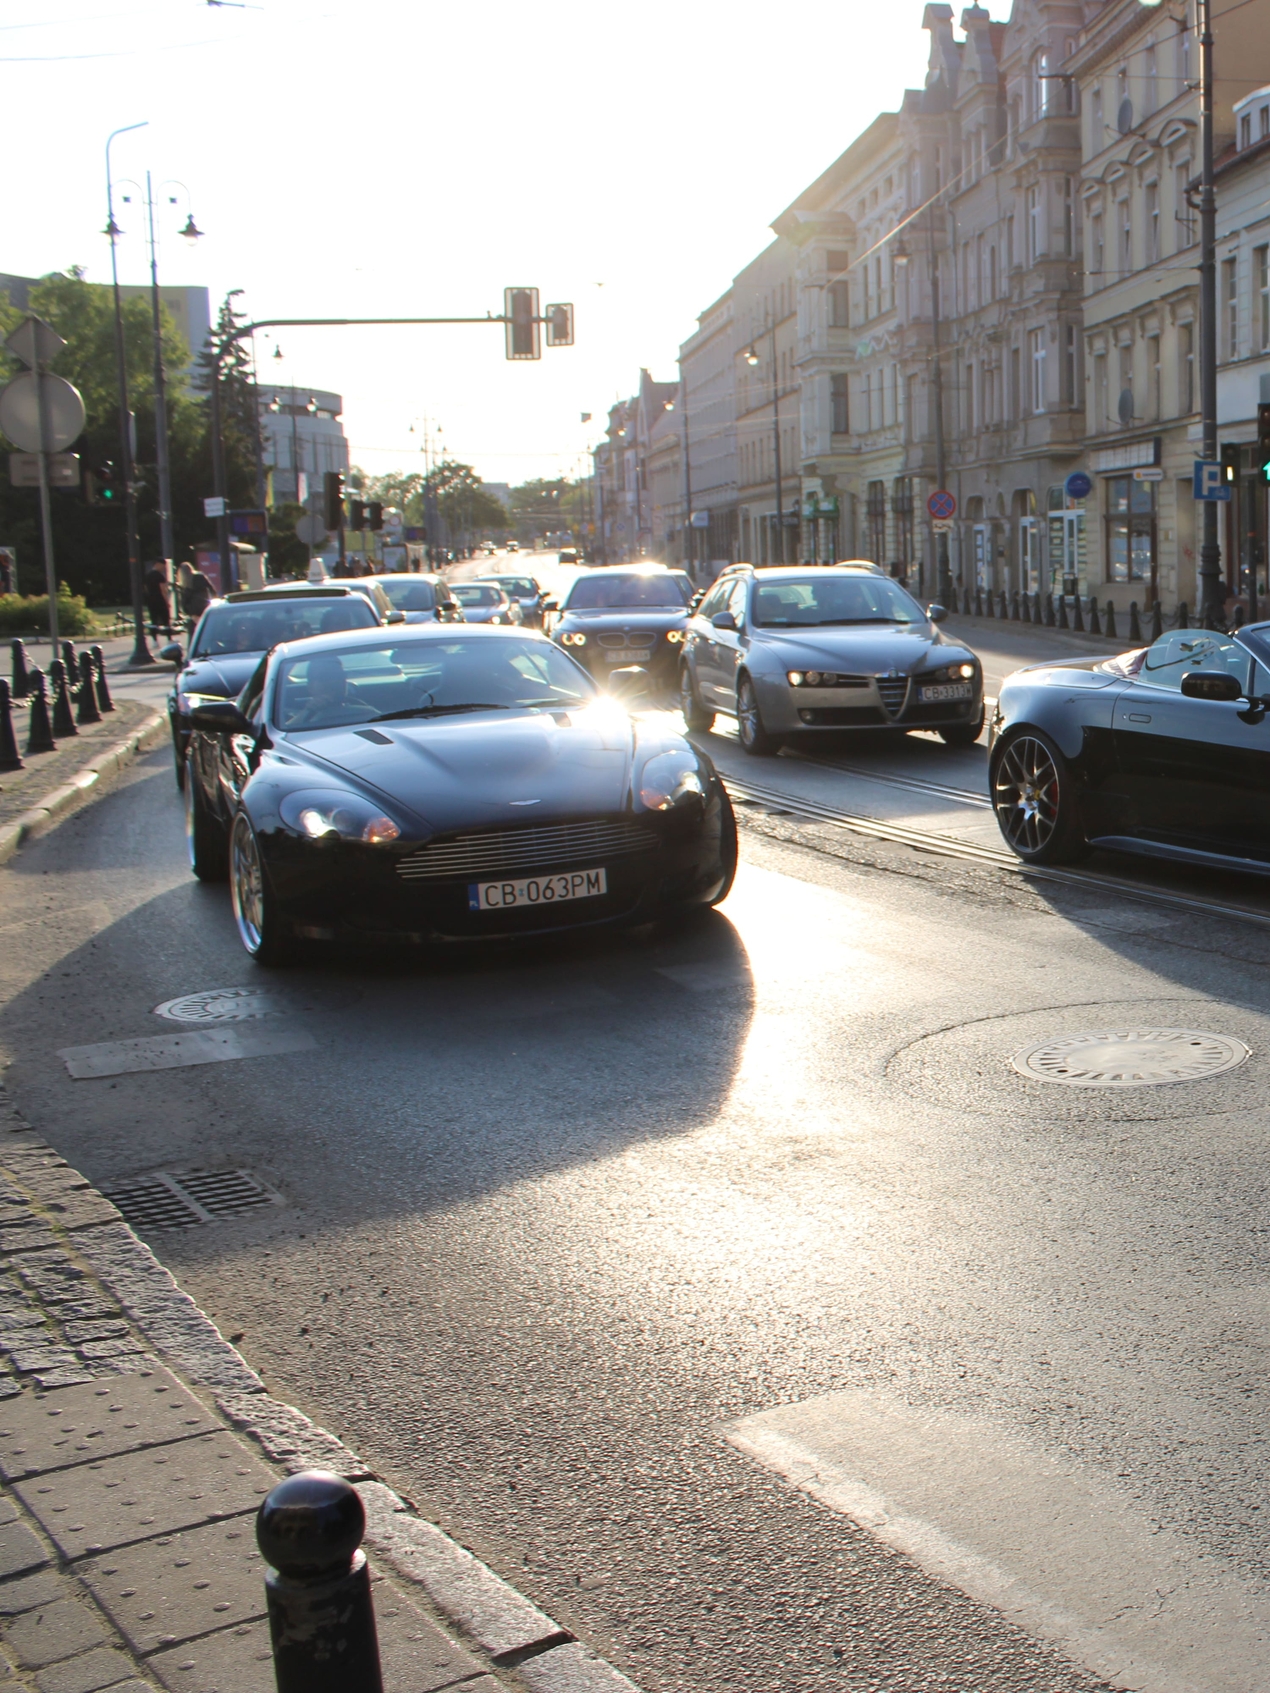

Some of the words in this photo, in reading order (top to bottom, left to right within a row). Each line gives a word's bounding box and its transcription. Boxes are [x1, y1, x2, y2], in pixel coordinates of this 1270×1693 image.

[924, 687, 939, 700] CB
[485, 883, 517, 907] CB
[527, 871, 600, 902] 063PM
